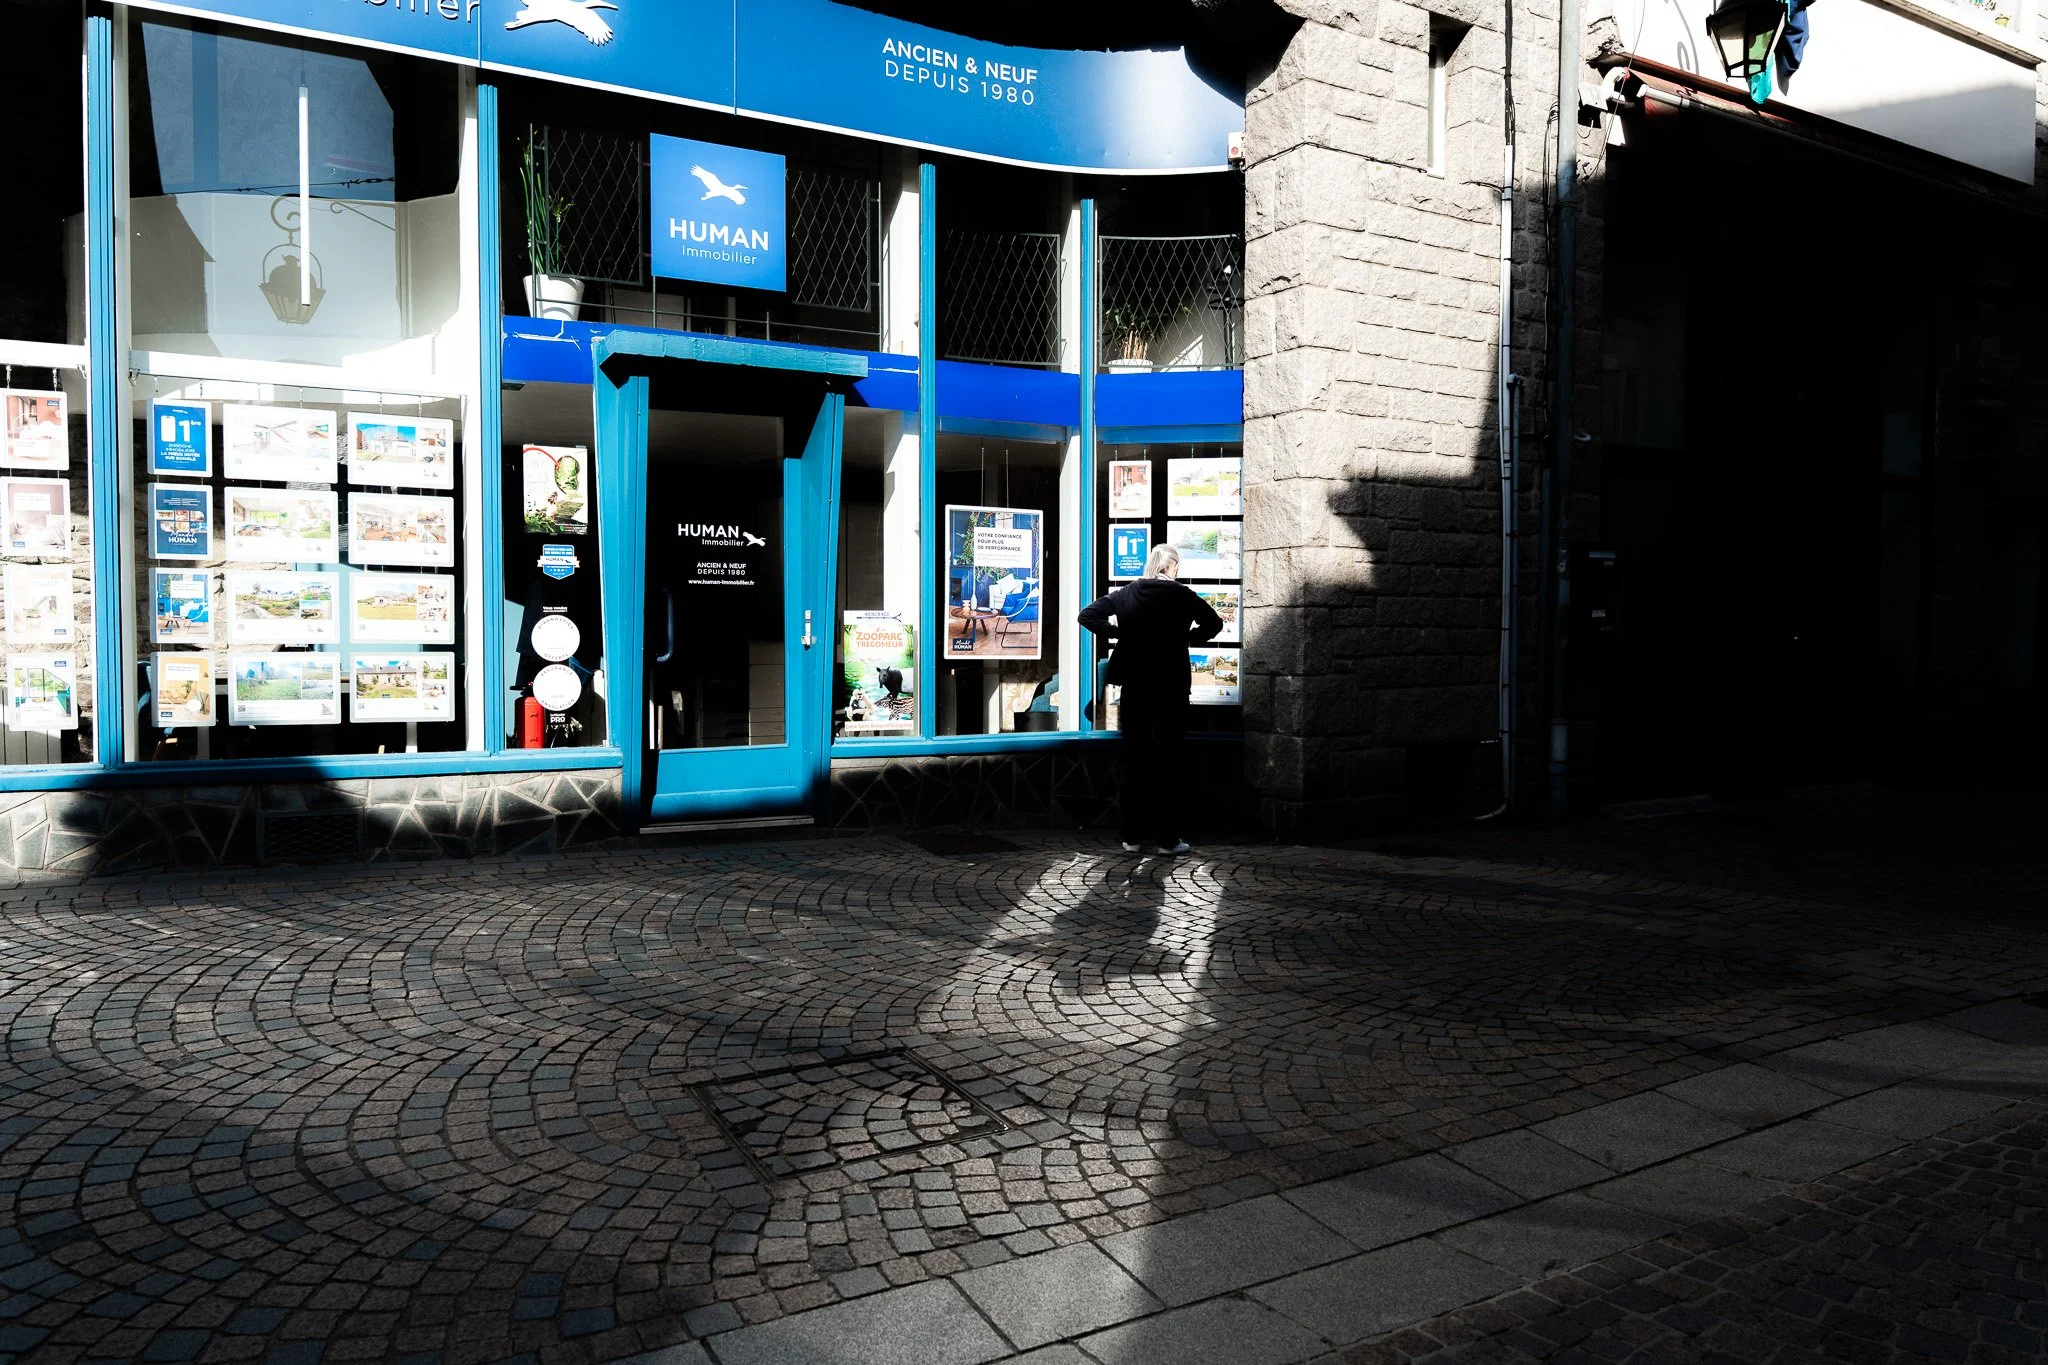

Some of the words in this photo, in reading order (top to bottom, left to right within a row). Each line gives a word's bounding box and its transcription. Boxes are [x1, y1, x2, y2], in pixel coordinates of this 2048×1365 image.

[882, 38, 958, 70] ANCIEN
[965, 57, 978, 74] &
[985, 60, 1038, 84] NEUF
[885, 60, 969, 93] DEPUIS
[981, 82, 1035, 105] 1980
[670, 218, 769, 251] HUMAN
[682, 245, 757, 264] Immobilier
[677, 523, 740, 539] HUMAN
[701, 538, 744, 547] Immobilier
[855, 632, 903, 641] ZOOPARC
